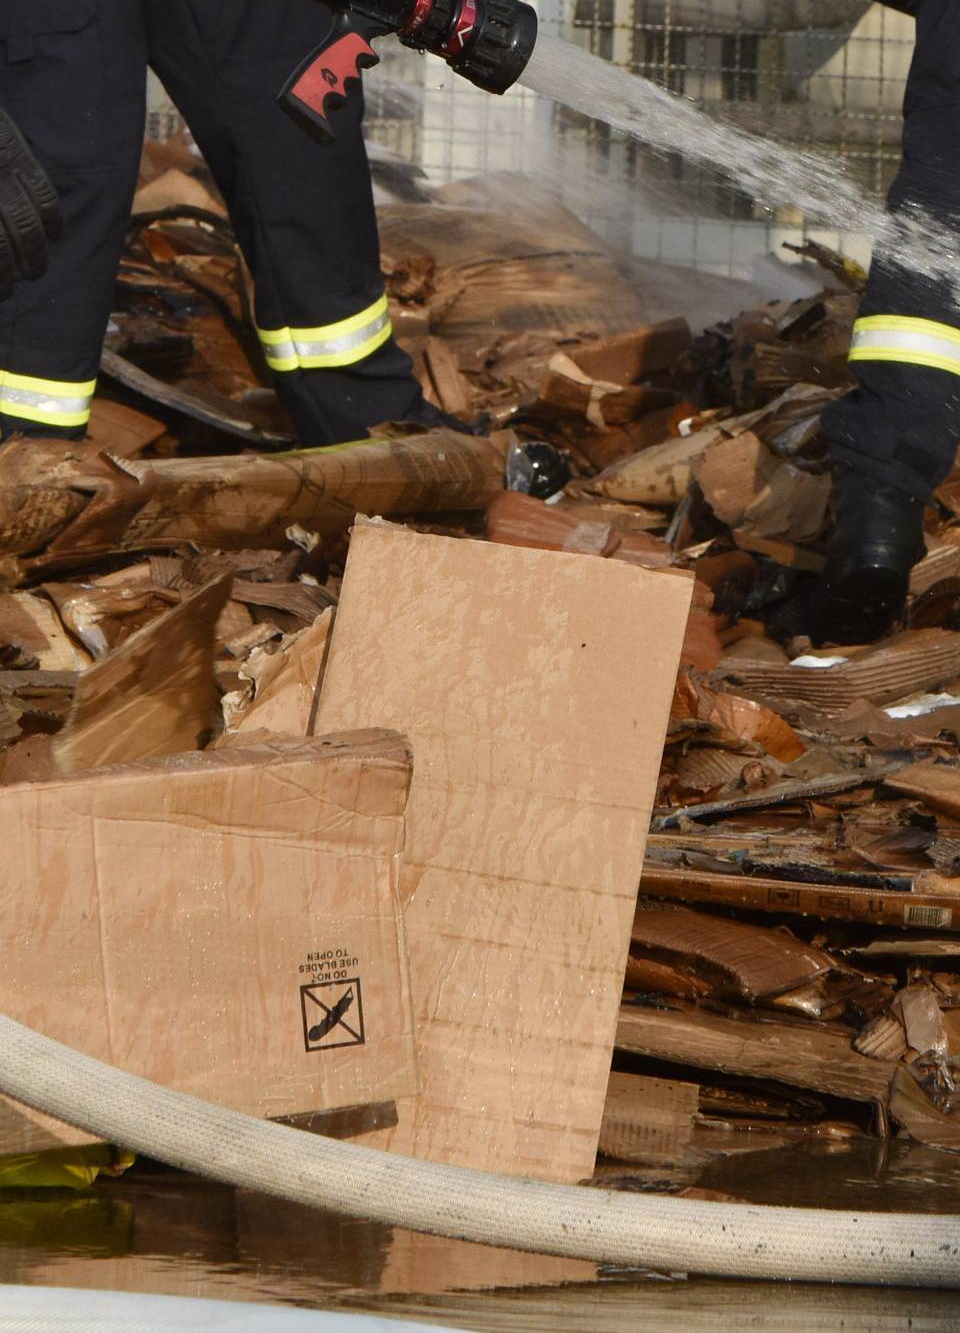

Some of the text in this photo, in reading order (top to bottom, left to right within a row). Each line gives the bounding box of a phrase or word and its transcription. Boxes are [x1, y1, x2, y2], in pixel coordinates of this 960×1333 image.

[307, 948, 349, 961] TO OPEN
[299, 957, 358, 973] USE BLADES
[312, 970, 347, 983] DO NOT
